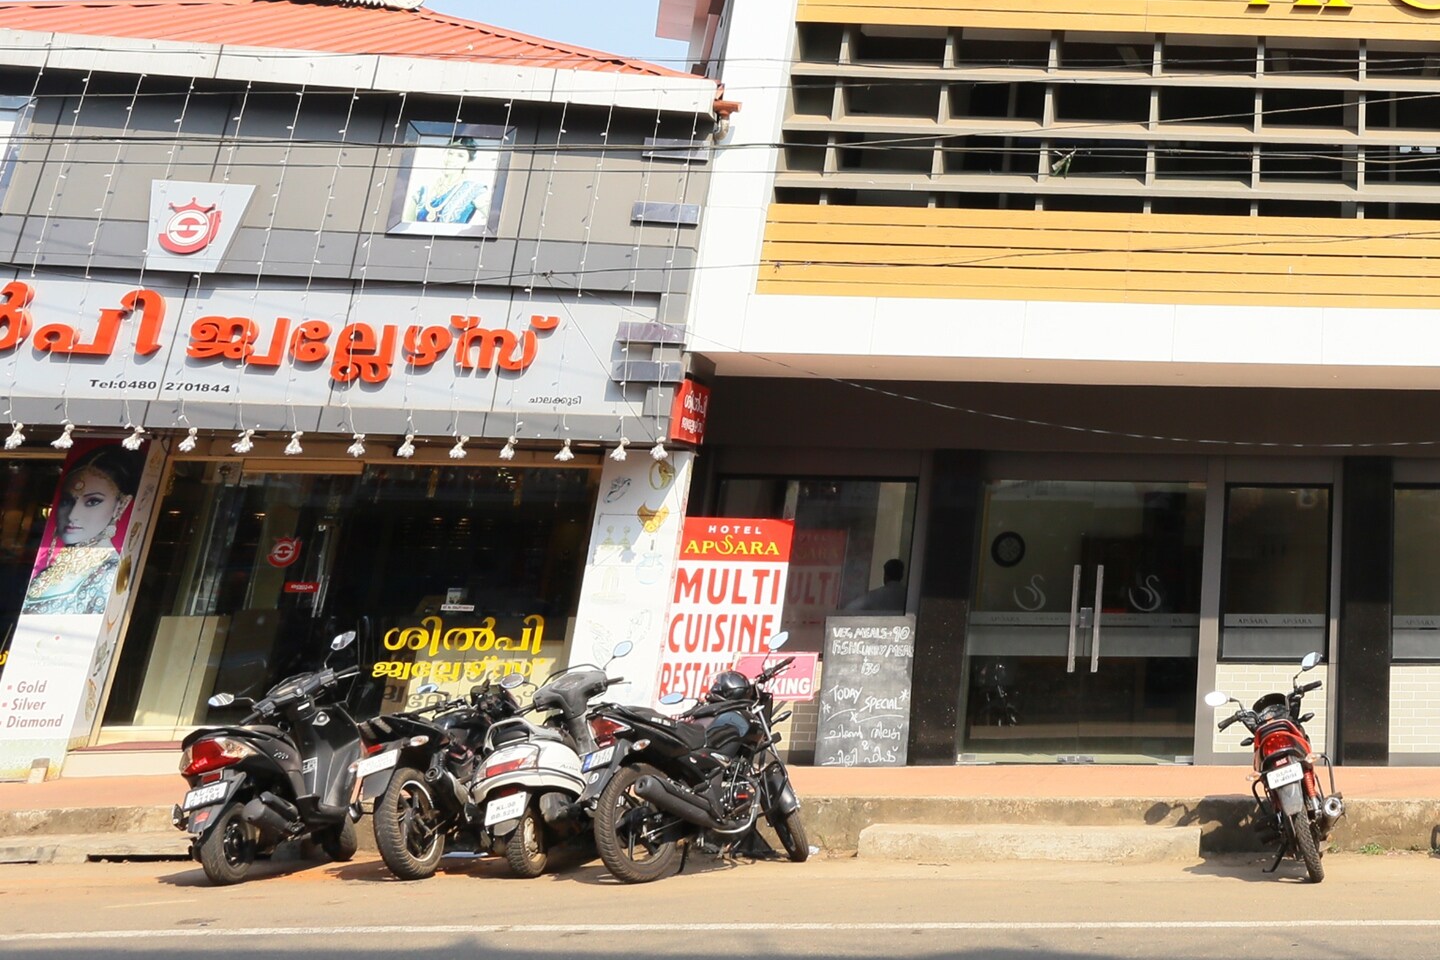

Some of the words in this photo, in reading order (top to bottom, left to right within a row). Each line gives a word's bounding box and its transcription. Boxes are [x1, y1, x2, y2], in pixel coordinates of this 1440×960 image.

[89, 379, 157, 391] Tel:0480
[165, 381, 231, 394] 2701844
[528, 394, 582, 407] ചാലക്കുടി
[708, 525, 762, 535] HOTEL
[684, 534, 780, 556] APSARA
[674, 568, 781, 605] MULTI
[384, 614, 544, 657] ശിൽപി
[668, 614, 773, 652] CUISINE
[833, 627, 852, 639] VEG
[17, 680, 47, 693] Gold
[11, 698, 46, 711] Silver
[829, 685, 863, 703] TODAY
[860, 695, 903, 712] SPECIAL
[6, 714, 64, 728] Diamond
